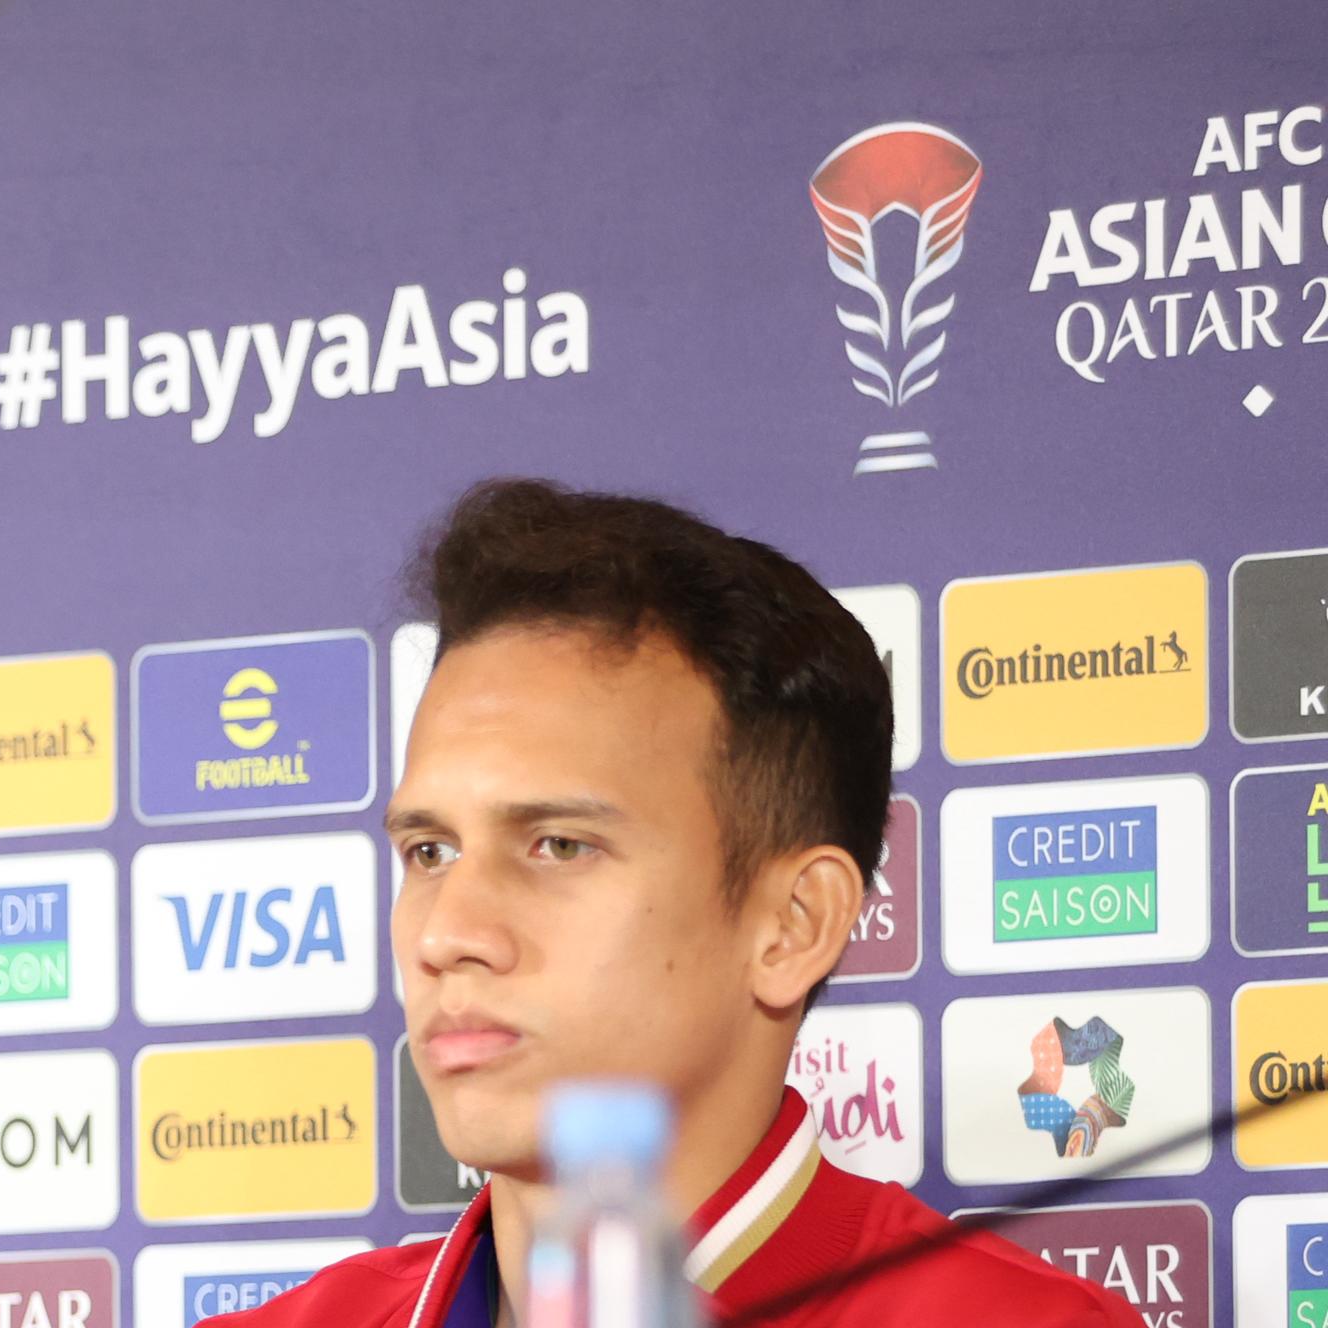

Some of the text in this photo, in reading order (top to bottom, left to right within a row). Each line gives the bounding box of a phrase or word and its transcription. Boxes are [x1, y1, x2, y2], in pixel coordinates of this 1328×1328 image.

[1192, 106, 1323, 177] AFC
[1028, 185, 1302, 293] ASIAN
[1055, 284, 1284, 383] QATAR
[957, 636, 1156, 699] Continental
[196, 754, 311, 791] FOOTBALL
[1008, 820, 1141, 868] CREDIT
[161, 886, 347, 972] VISA
[1000, 883, 1150, 931] SAISON
[794, 1036, 848, 1077] isit
[809, 1059, 905, 1143] udi
[152, 1107, 330, 1161] Continental
[194, 1279, 308, 1321] CRED
[1040, 1244, 1184, 1304] TAR
